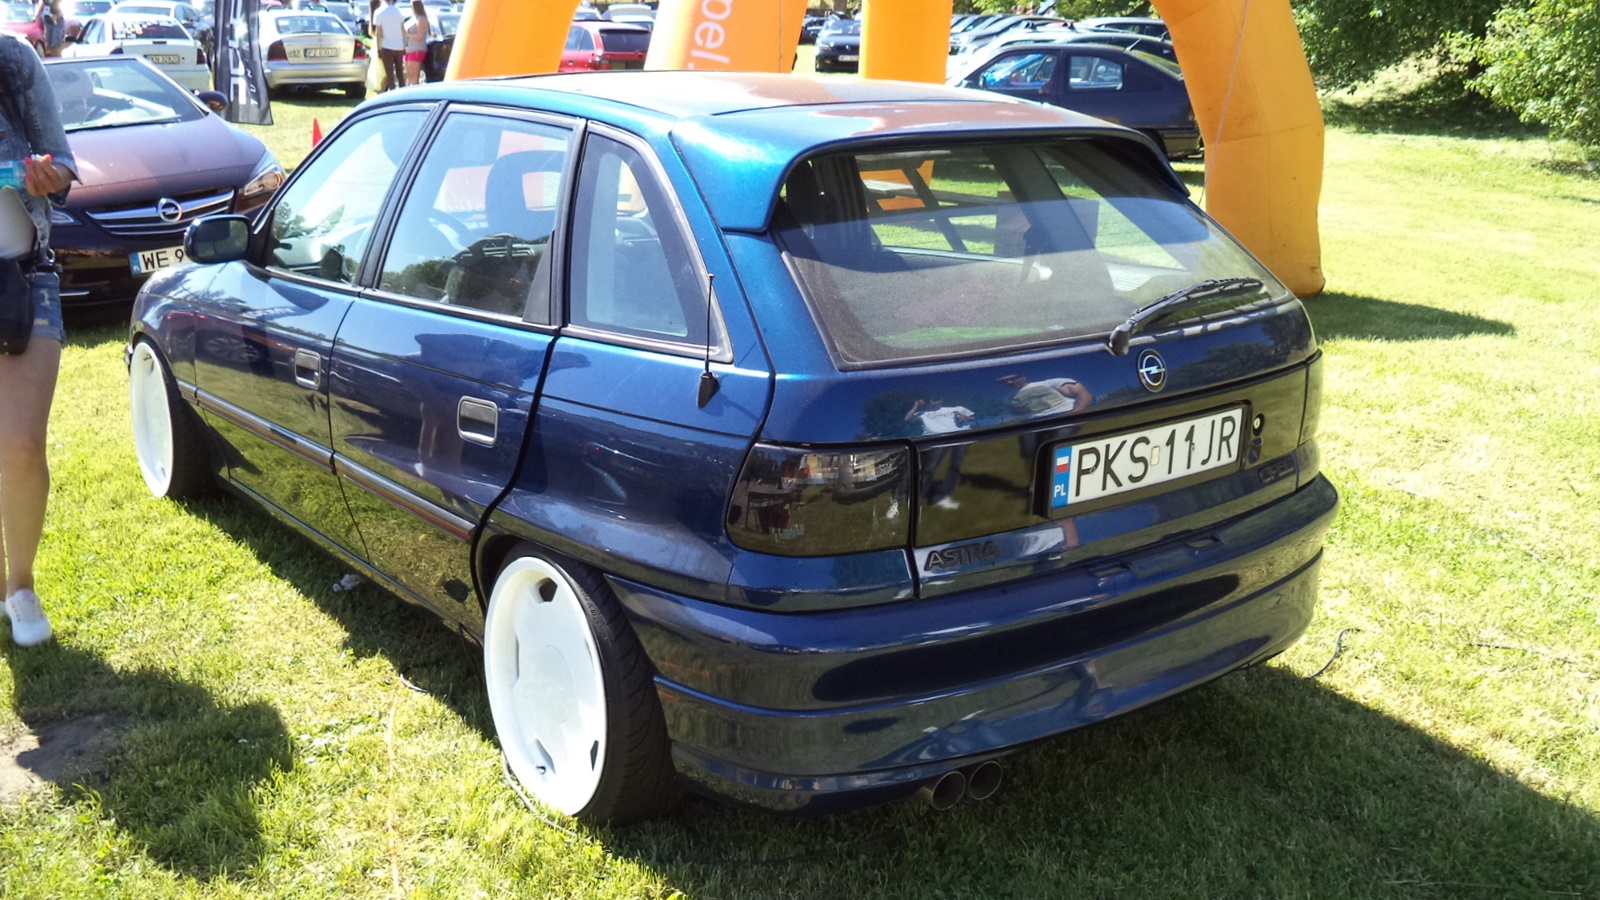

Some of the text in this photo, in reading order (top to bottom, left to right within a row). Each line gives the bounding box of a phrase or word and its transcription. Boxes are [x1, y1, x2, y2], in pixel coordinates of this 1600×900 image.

[142, 251, 170, 270] WE
[1054, 415, 1236, 497] PL PKS 11JR
[924, 541, 1003, 572] ASTRA
